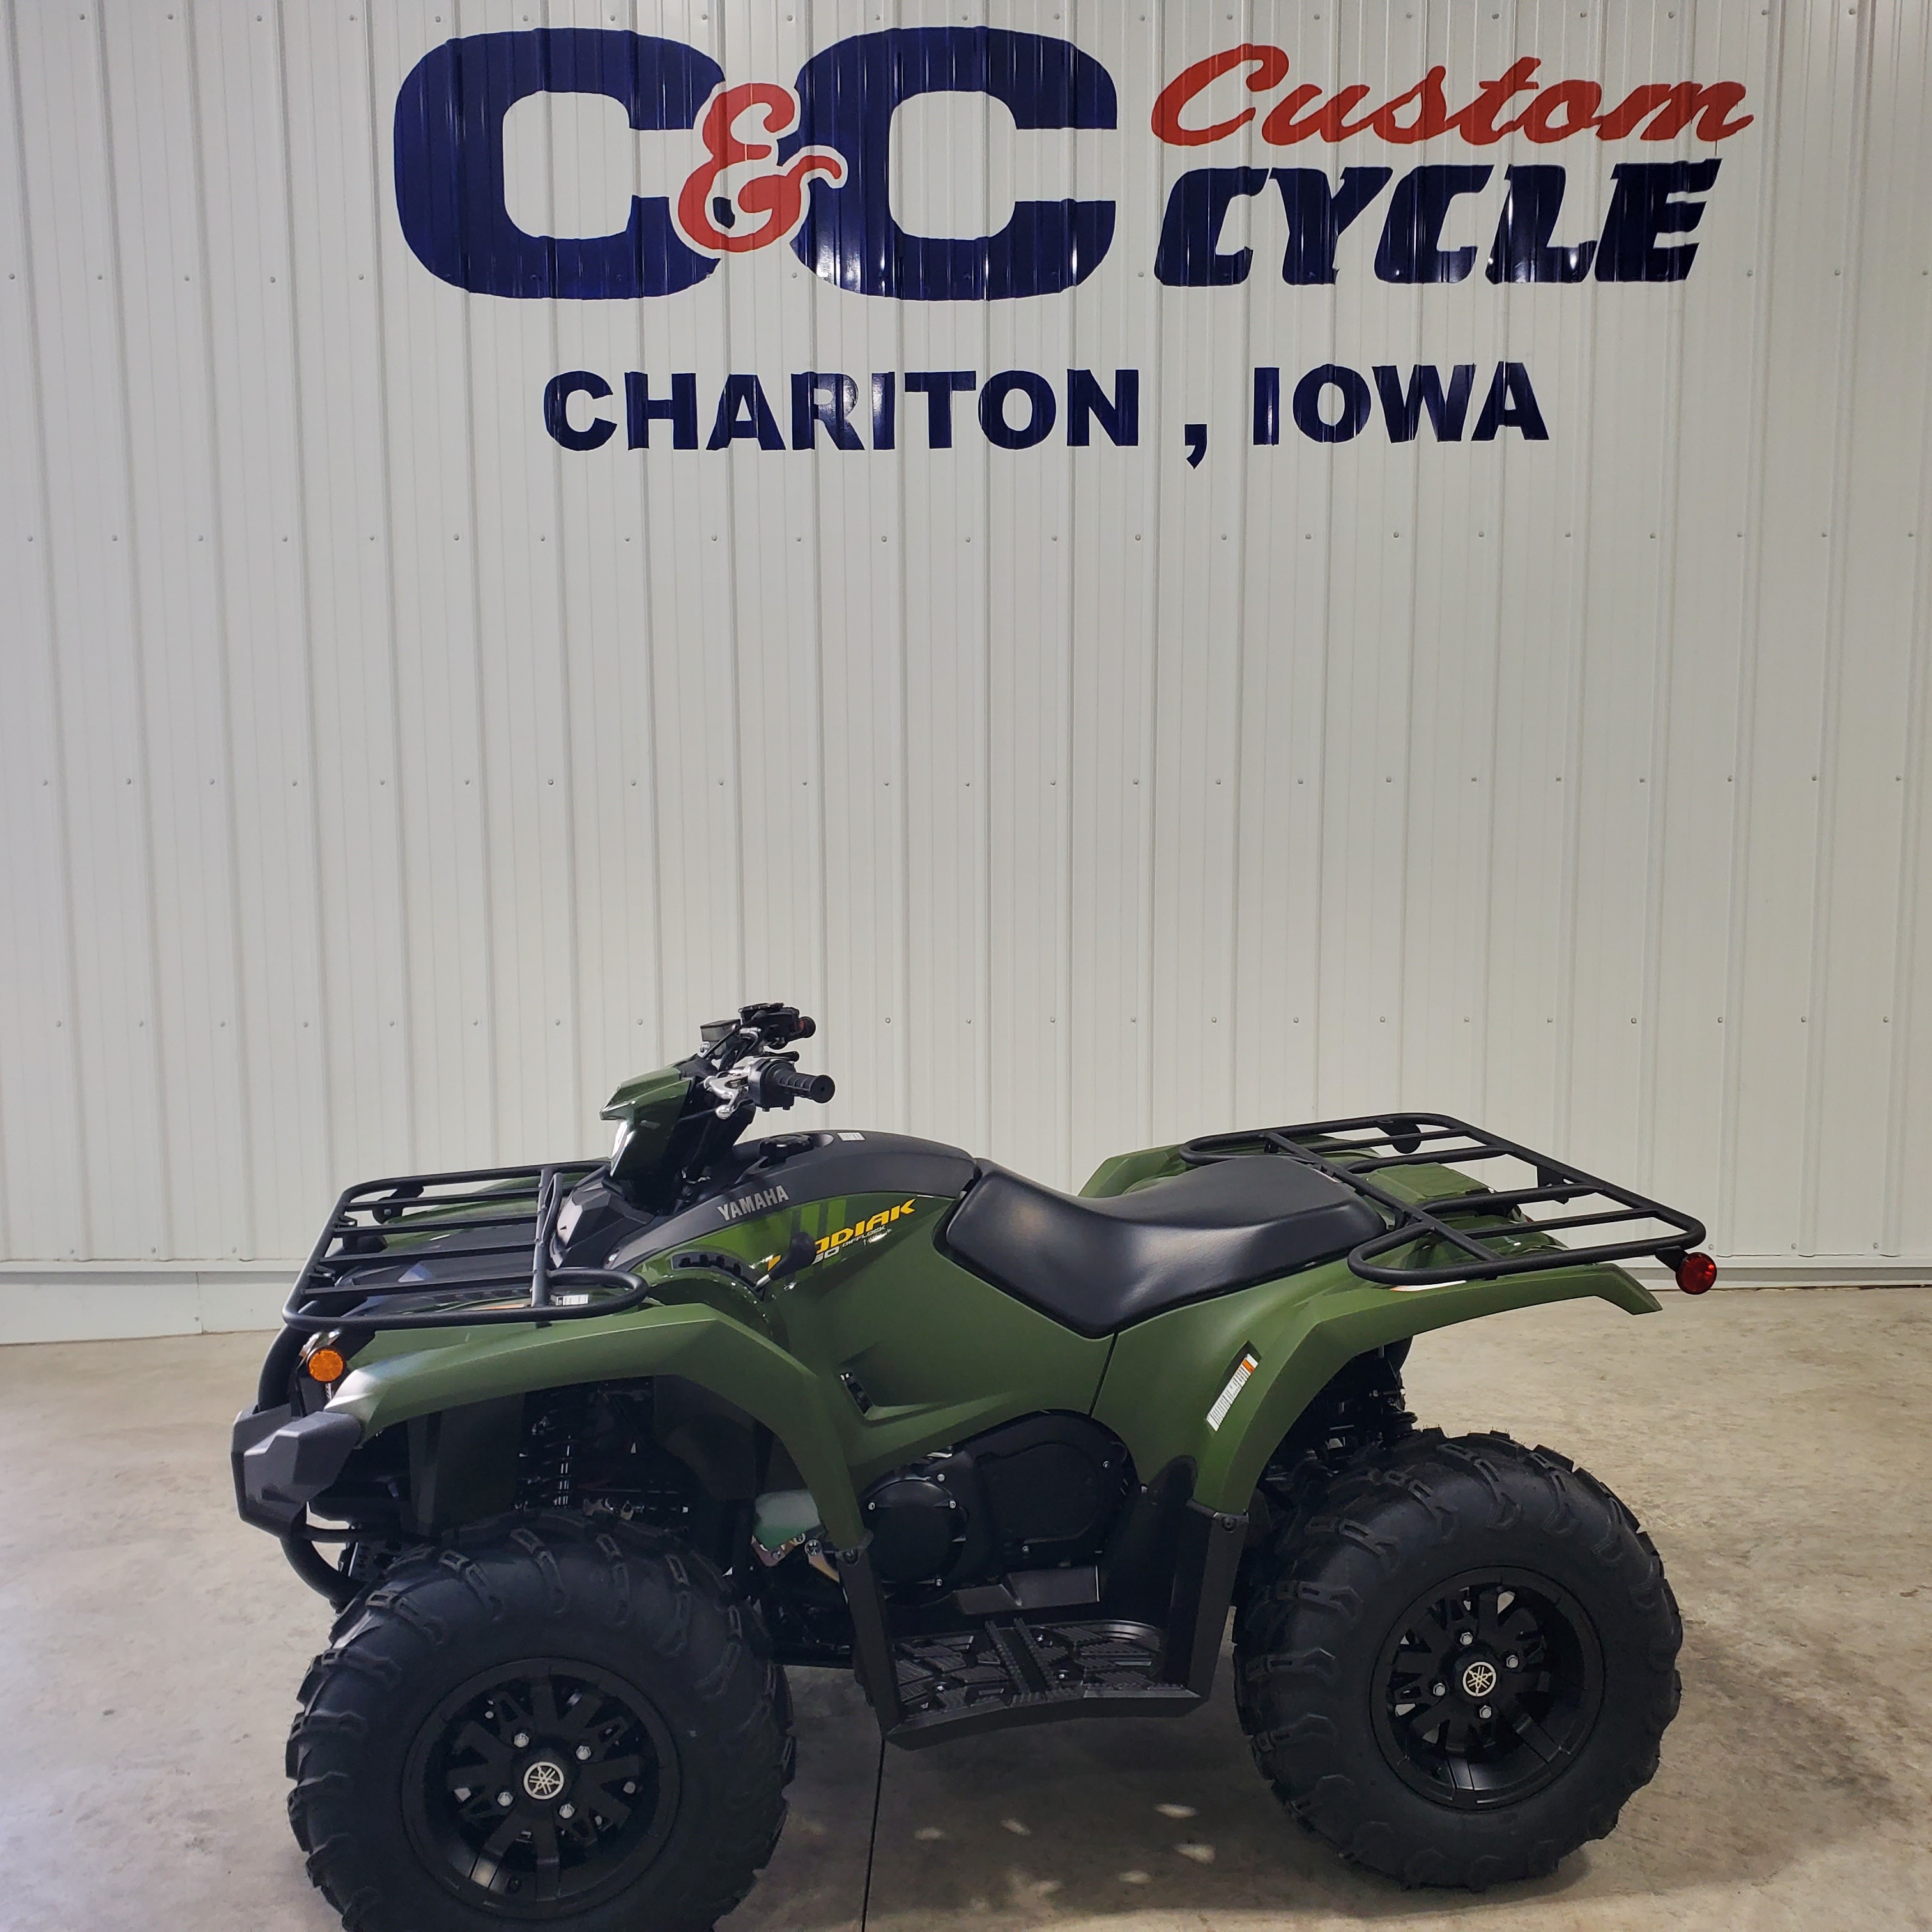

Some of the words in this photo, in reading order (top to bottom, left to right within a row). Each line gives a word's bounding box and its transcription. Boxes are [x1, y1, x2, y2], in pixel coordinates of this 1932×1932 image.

[1151, 43, 1754, 146] Custom
[393, 27, 1117, 302] C&C
[1154, 158, 1722, 288] CYCLE
[543, 368, 1139, 452] CHARITON
[1253, 361, 1549, 447] IOWA
[717, 1185, 790, 1222] YAMAHA
[767, 1198, 916, 1272] ODIAK
[811, 1246, 841, 1265] 50
